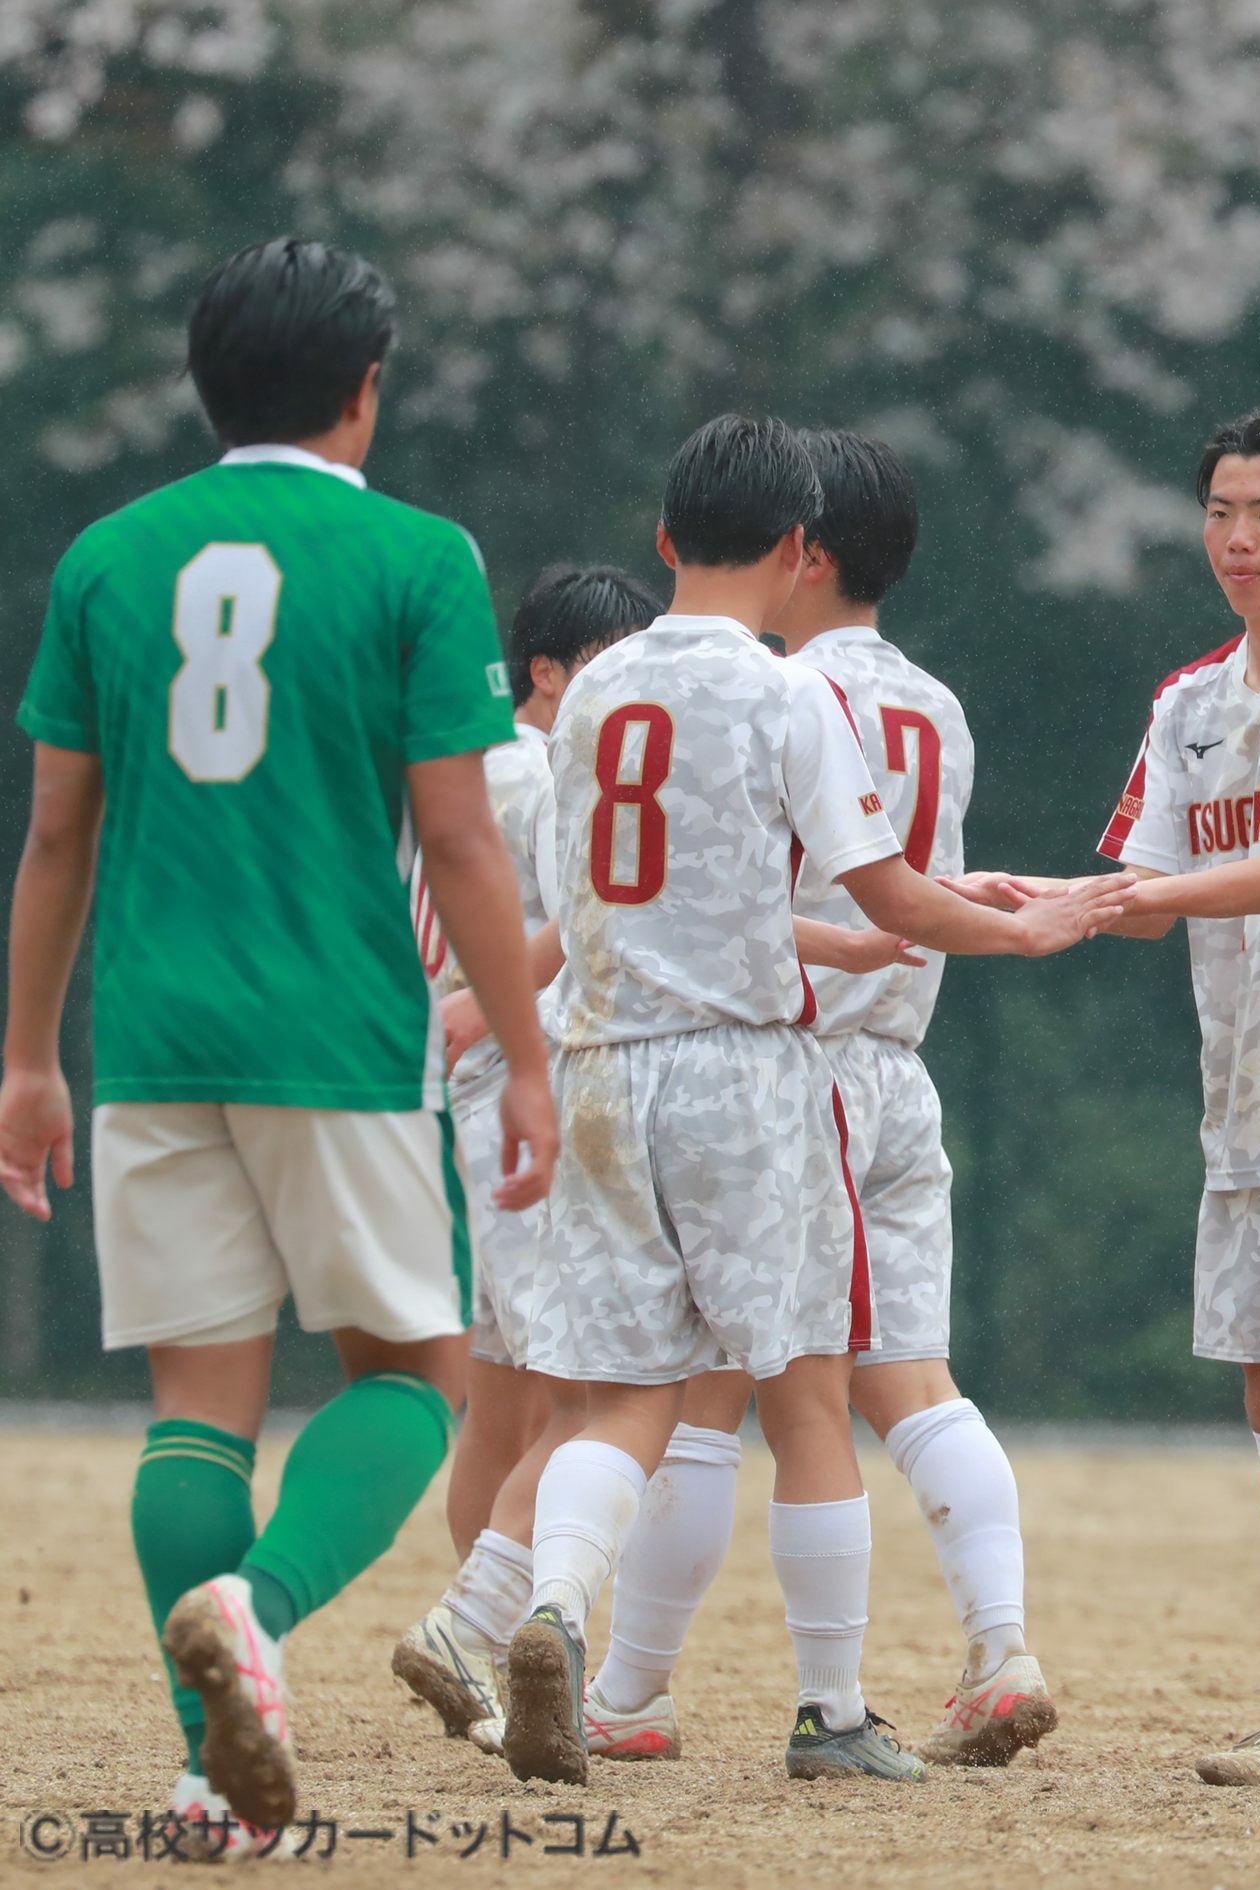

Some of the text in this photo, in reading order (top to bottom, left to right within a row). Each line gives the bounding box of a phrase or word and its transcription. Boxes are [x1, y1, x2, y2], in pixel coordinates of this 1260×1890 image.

[168, 541, 283, 783] 8
[589, 702, 674, 907] 8
[877, 703, 942, 877] 7
